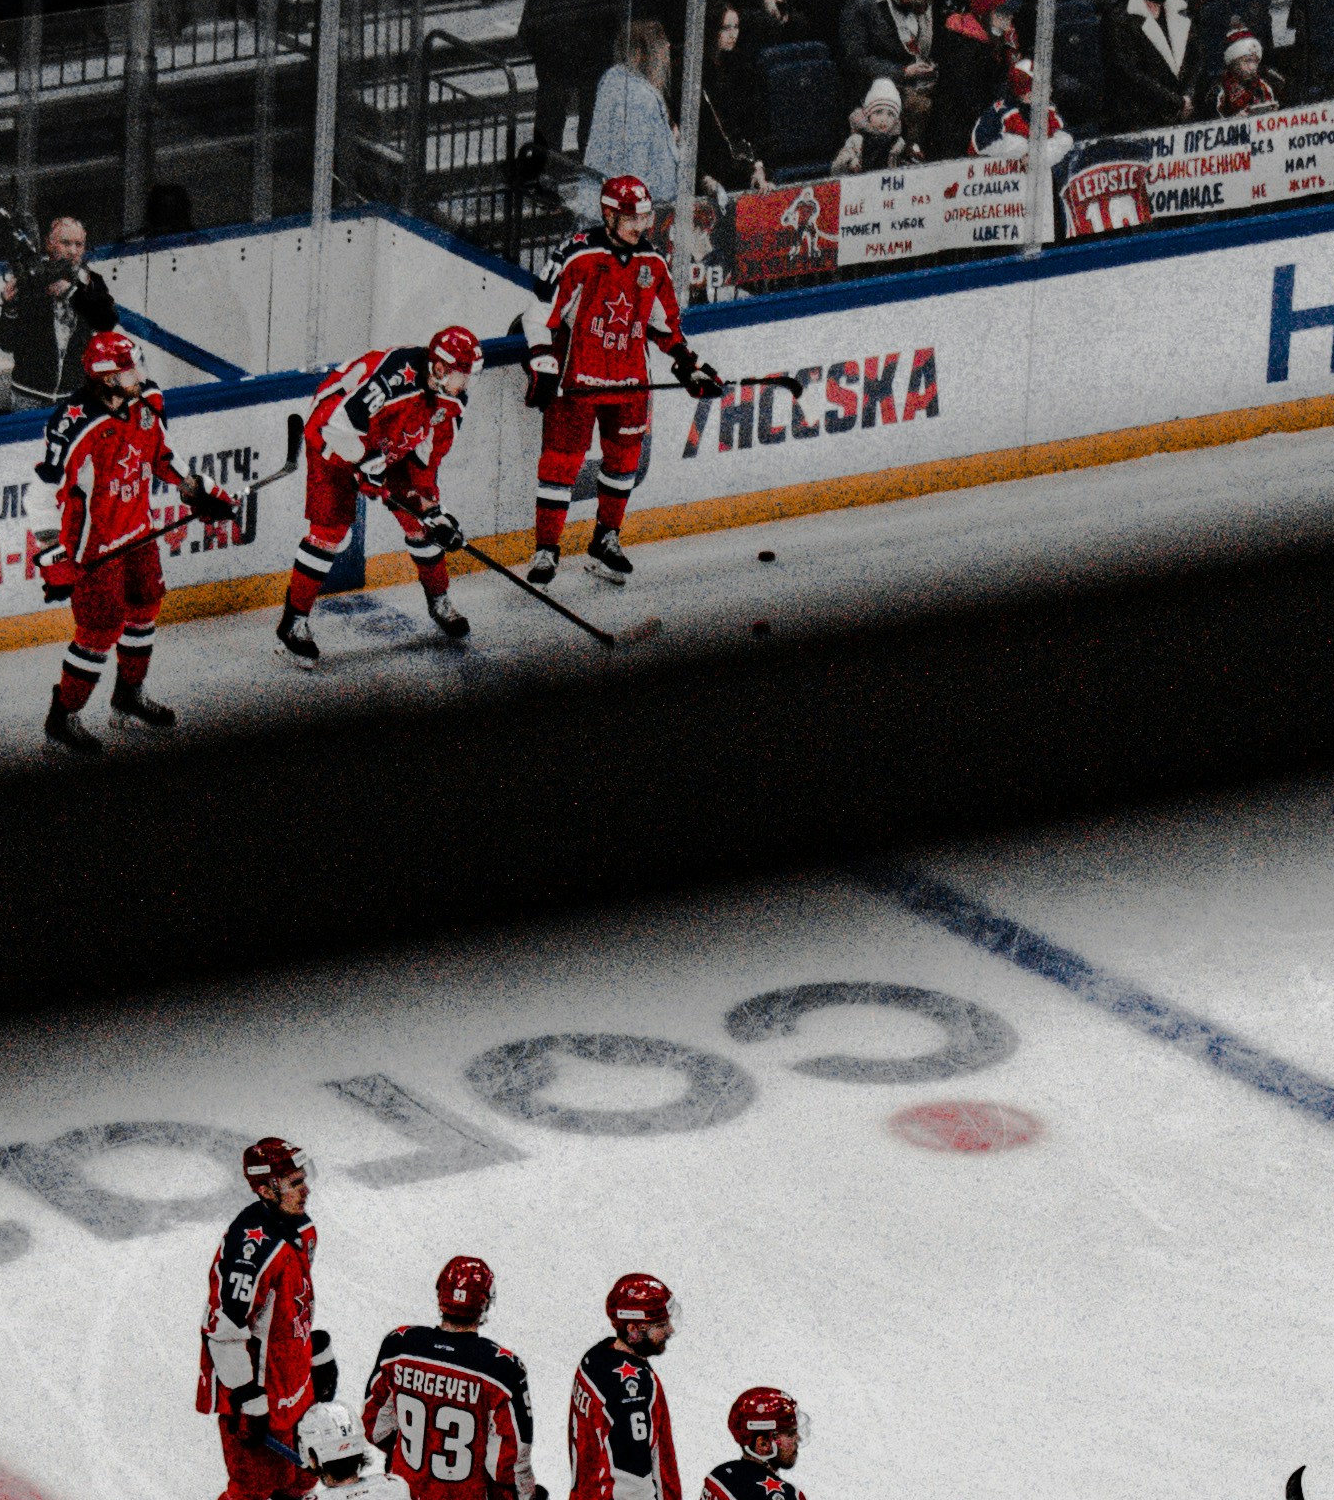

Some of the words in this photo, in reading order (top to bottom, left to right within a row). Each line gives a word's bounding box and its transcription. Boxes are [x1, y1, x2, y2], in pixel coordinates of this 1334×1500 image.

[1250, 138, 1274, 156] БЕЗ
[1285, 154, 1317, 173] НАМ
[880, 176, 905, 192] МЫ
[963, 180, 1020, 198] СЕРДЦАХ
[1074, 165, 1140, 202] LEIPSIC
[1252, 182, 1268, 199] НЕ
[883, 199, 895, 211] НЕ
[911, 194, 931, 206] РАЗ
[841, 221, 881, 238] ТРОНЕМ
[890, 217, 926, 232] КУБОК
[973, 224, 1020, 242] ЦВЕТА
[865, 240, 913, 257] РУКАМИ
[589, 315, 645, 353] ЦСКА
[228, 1271, 255, 1303] 75
[393, 1363, 482, 1406] SERGEYEV
[630, 1411, 648, 1441] 6
[396, 1393, 478, 1482] 93
